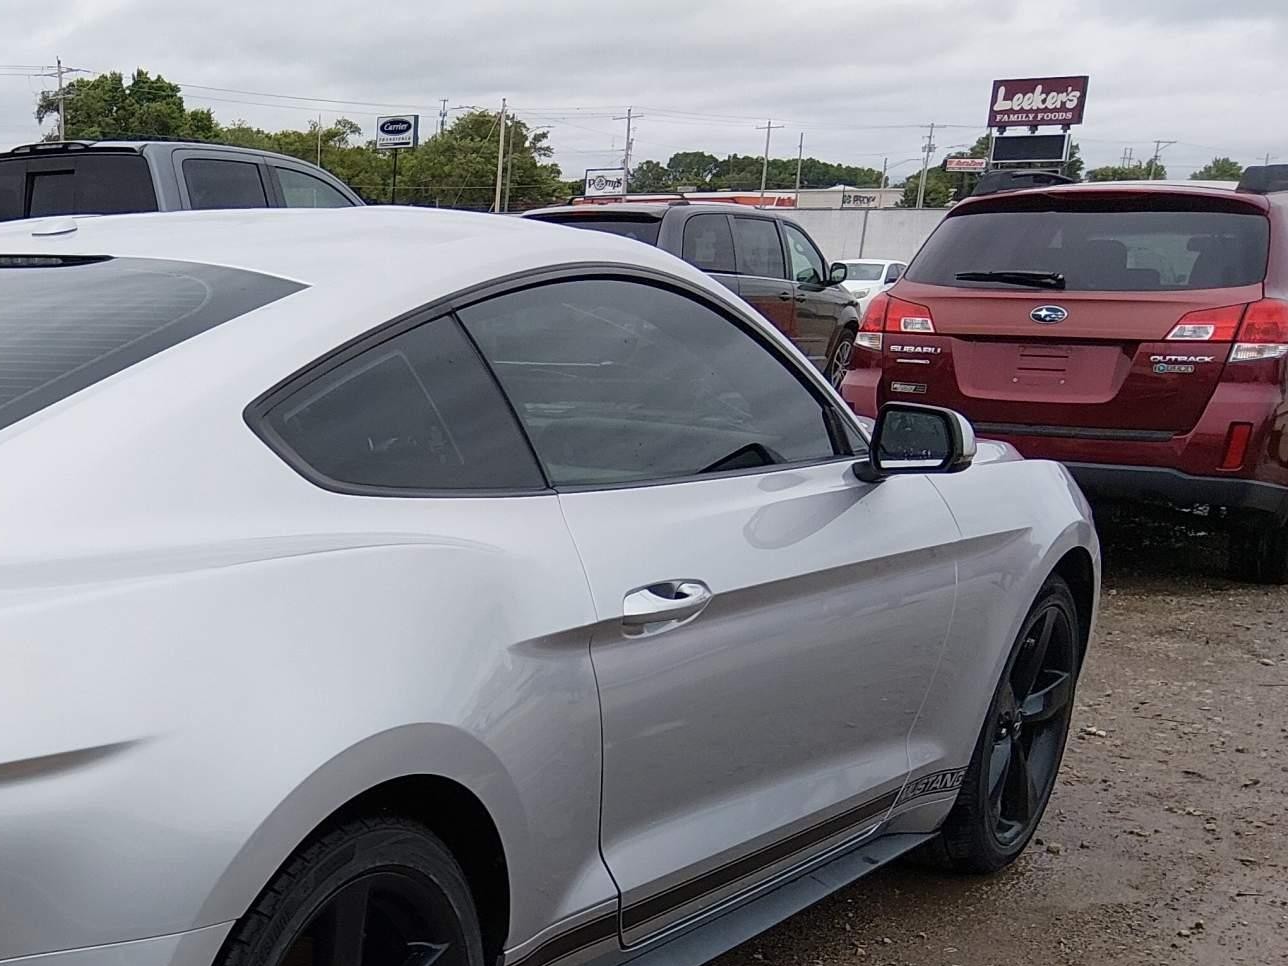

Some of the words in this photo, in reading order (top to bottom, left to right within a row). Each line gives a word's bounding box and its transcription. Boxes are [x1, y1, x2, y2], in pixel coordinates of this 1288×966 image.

[993, 85, 1080, 111] Leeker's
[995, 113, 1035, 122] FAMILY
[1036, 112, 1072, 121] FOODS
[384, 123, 409, 131] Carrier
[890, 345, 942, 354] SUBARU
